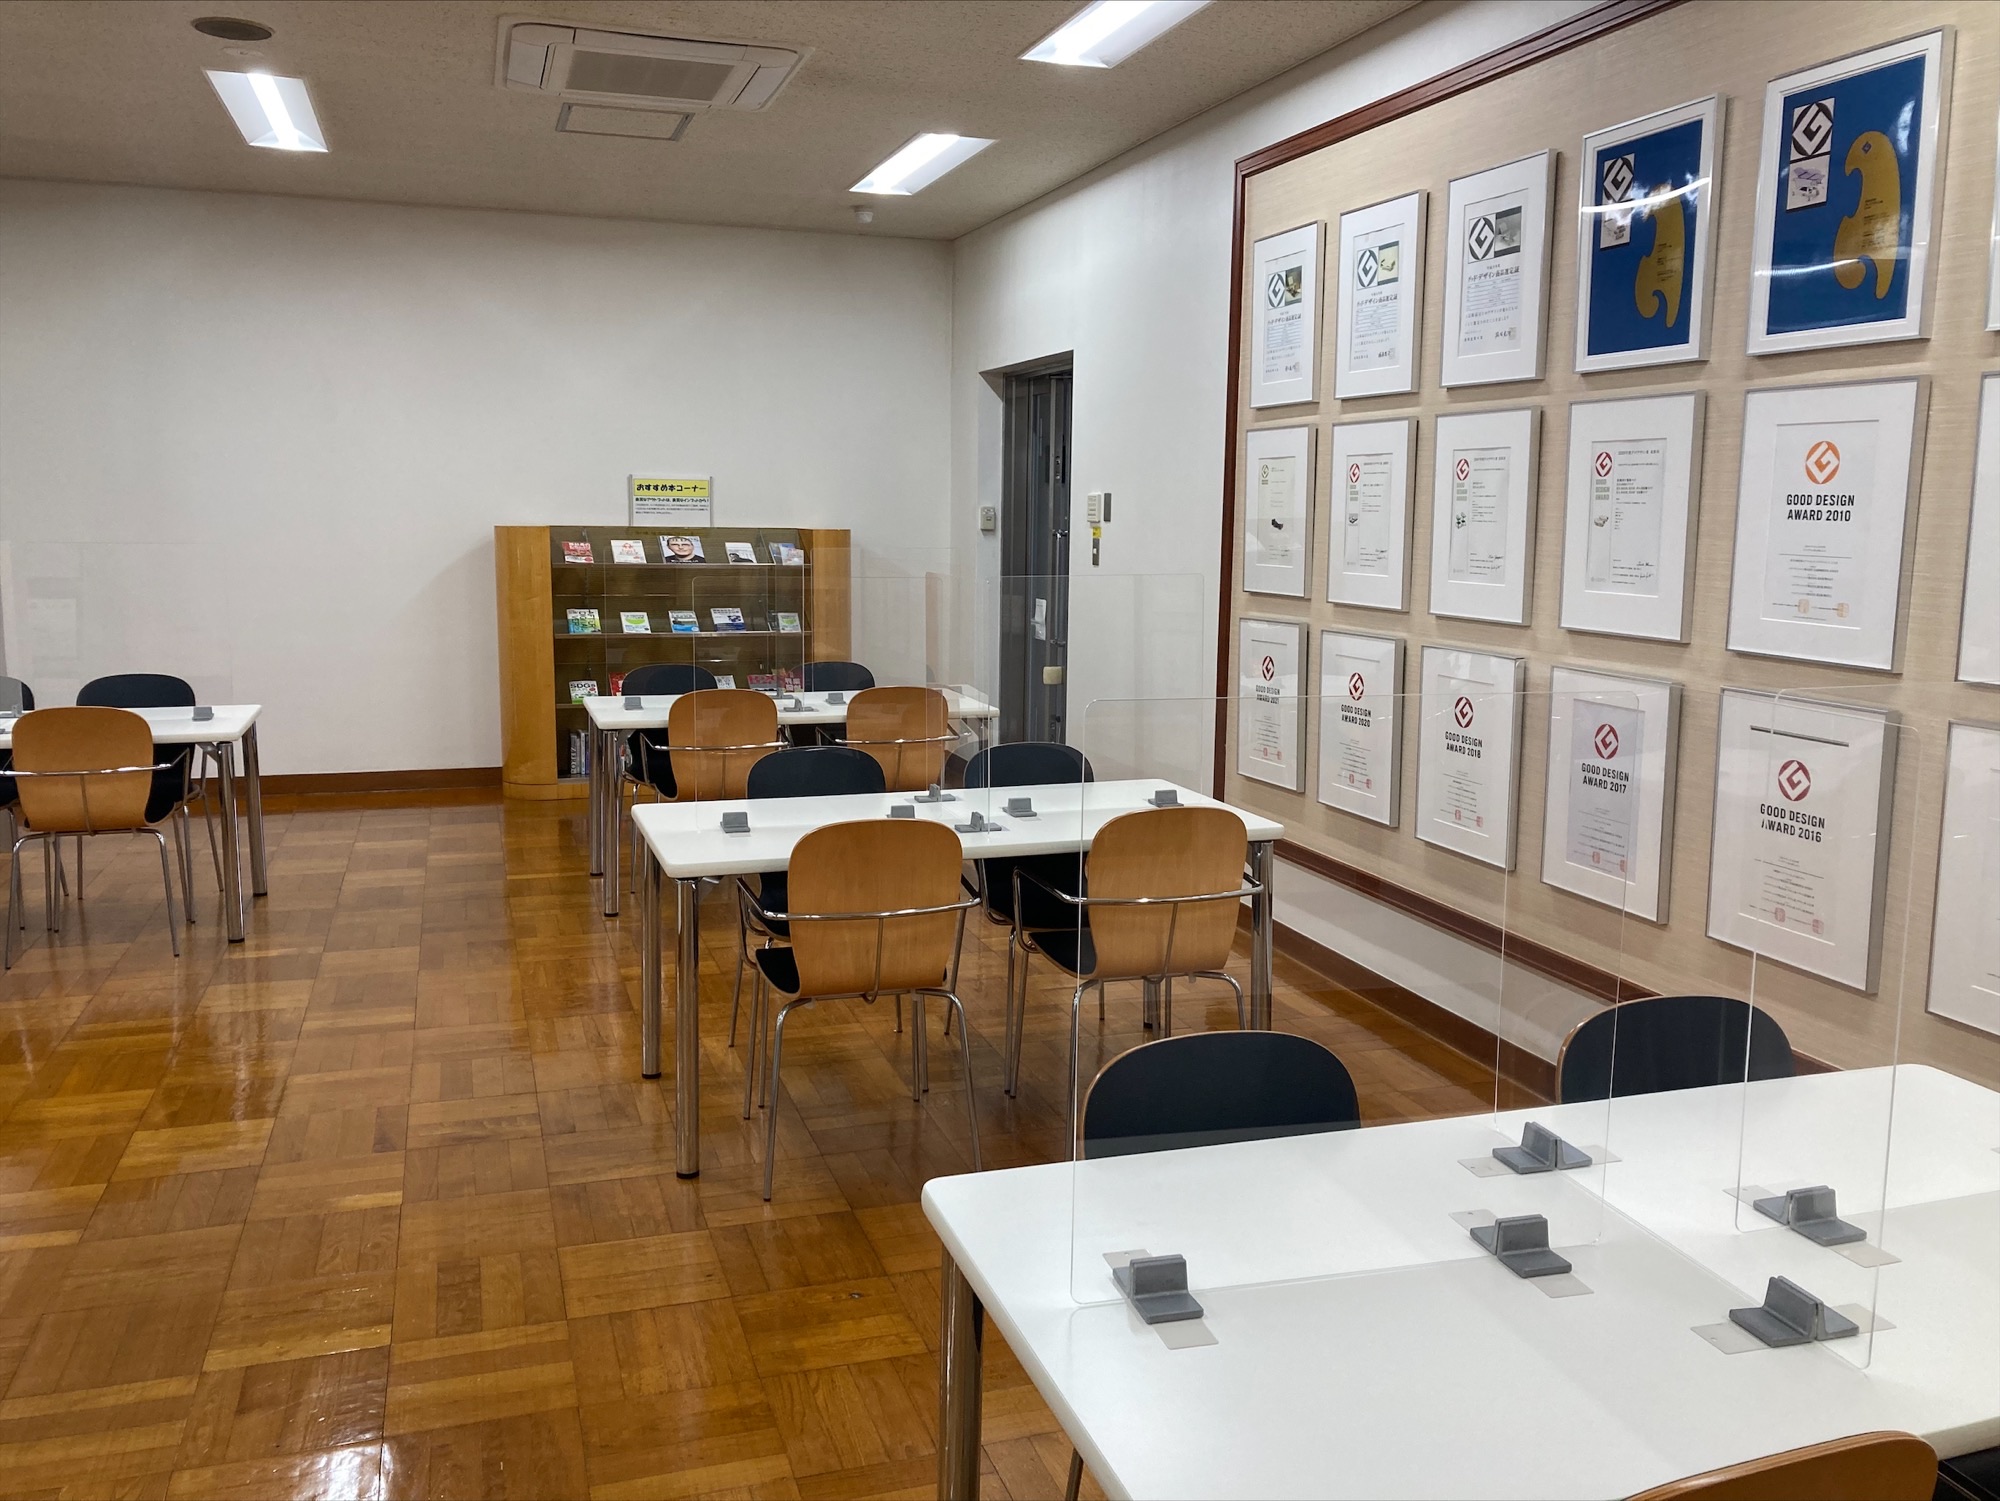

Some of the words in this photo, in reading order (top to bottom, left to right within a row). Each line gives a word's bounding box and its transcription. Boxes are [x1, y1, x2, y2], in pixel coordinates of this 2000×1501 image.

[636, 483, 707, 492] おすすめ本コーナー
[1786, 494, 1813, 506] GOOD
[1815, 494, 1855, 507] DESIGN
[1787, 509, 1823, 521] AWARD
[1825, 510, 1851, 522] 2010
[1341, 704, 1354, 714] GOOD
[1354, 706, 1372, 718] DESIGN
[1341, 714, 1358, 725] AWARD
[1358, 717, 1371, 728] 2020
[1444, 731, 1460, 743] GOOD
[1461, 735, 1483, 749] DESIGN
[1446, 742, 1466, 755] AWARD
[1467, 747, 1481, 759] 2018
[1581, 762, 1601, 776] GOOD
[1602, 767, 1630, 783] DESIGN
[1582, 775, 1608, 790] AWARD
[1609, 781, 1627, 794] 2017
[1760, 803, 1786, 819] GOOD
[1789, 810, 1825, 829] DESIGN
[1798, 827, 1822, 843] 2016
